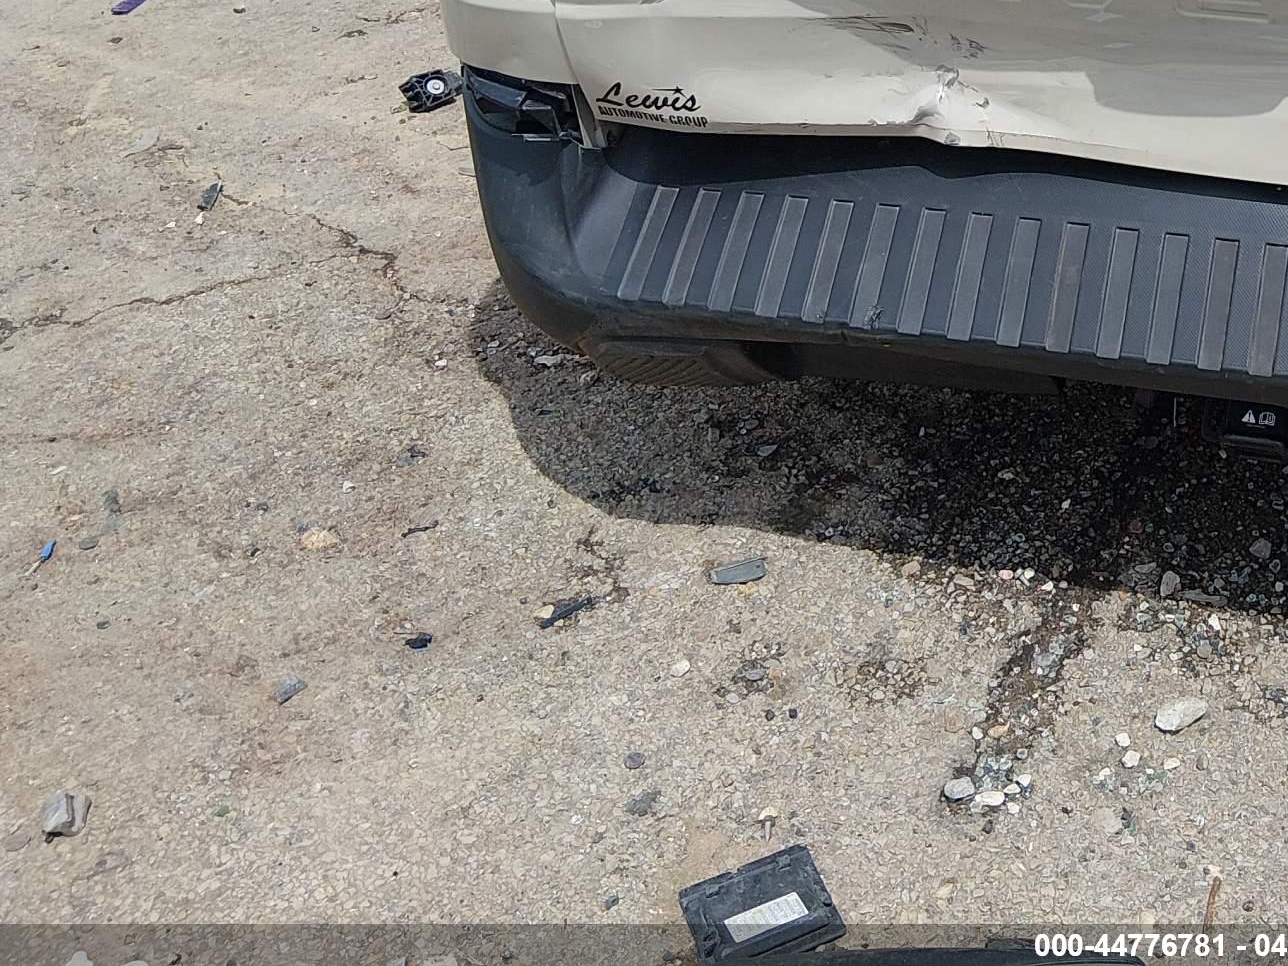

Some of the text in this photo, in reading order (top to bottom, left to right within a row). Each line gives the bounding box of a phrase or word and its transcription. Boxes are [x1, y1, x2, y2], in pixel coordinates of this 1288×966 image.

[595, 81, 702, 113] Lewis
[597, 105, 709, 129] AUTOMOTIVE GROUP
